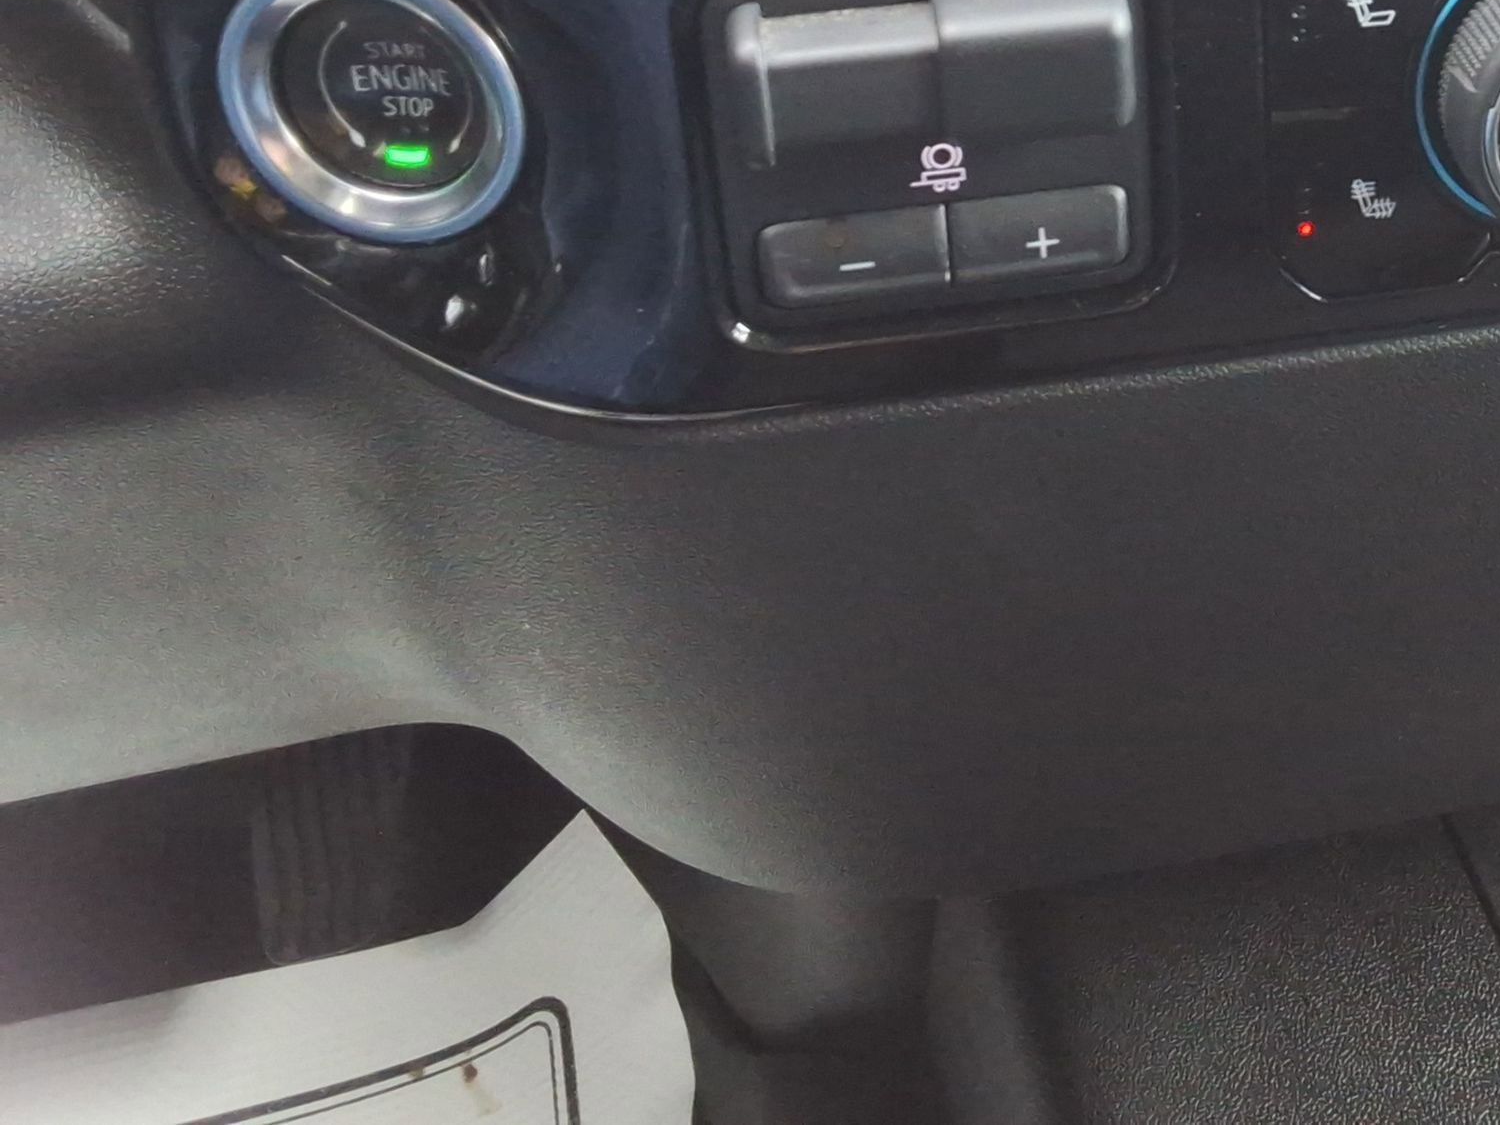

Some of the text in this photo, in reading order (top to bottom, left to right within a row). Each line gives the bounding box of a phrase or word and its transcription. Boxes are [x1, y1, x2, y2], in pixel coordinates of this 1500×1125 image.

[363, 41, 426, 60] START
[350, 64, 452, 96] ENGINE
[382, 95, 435, 118] STOP
